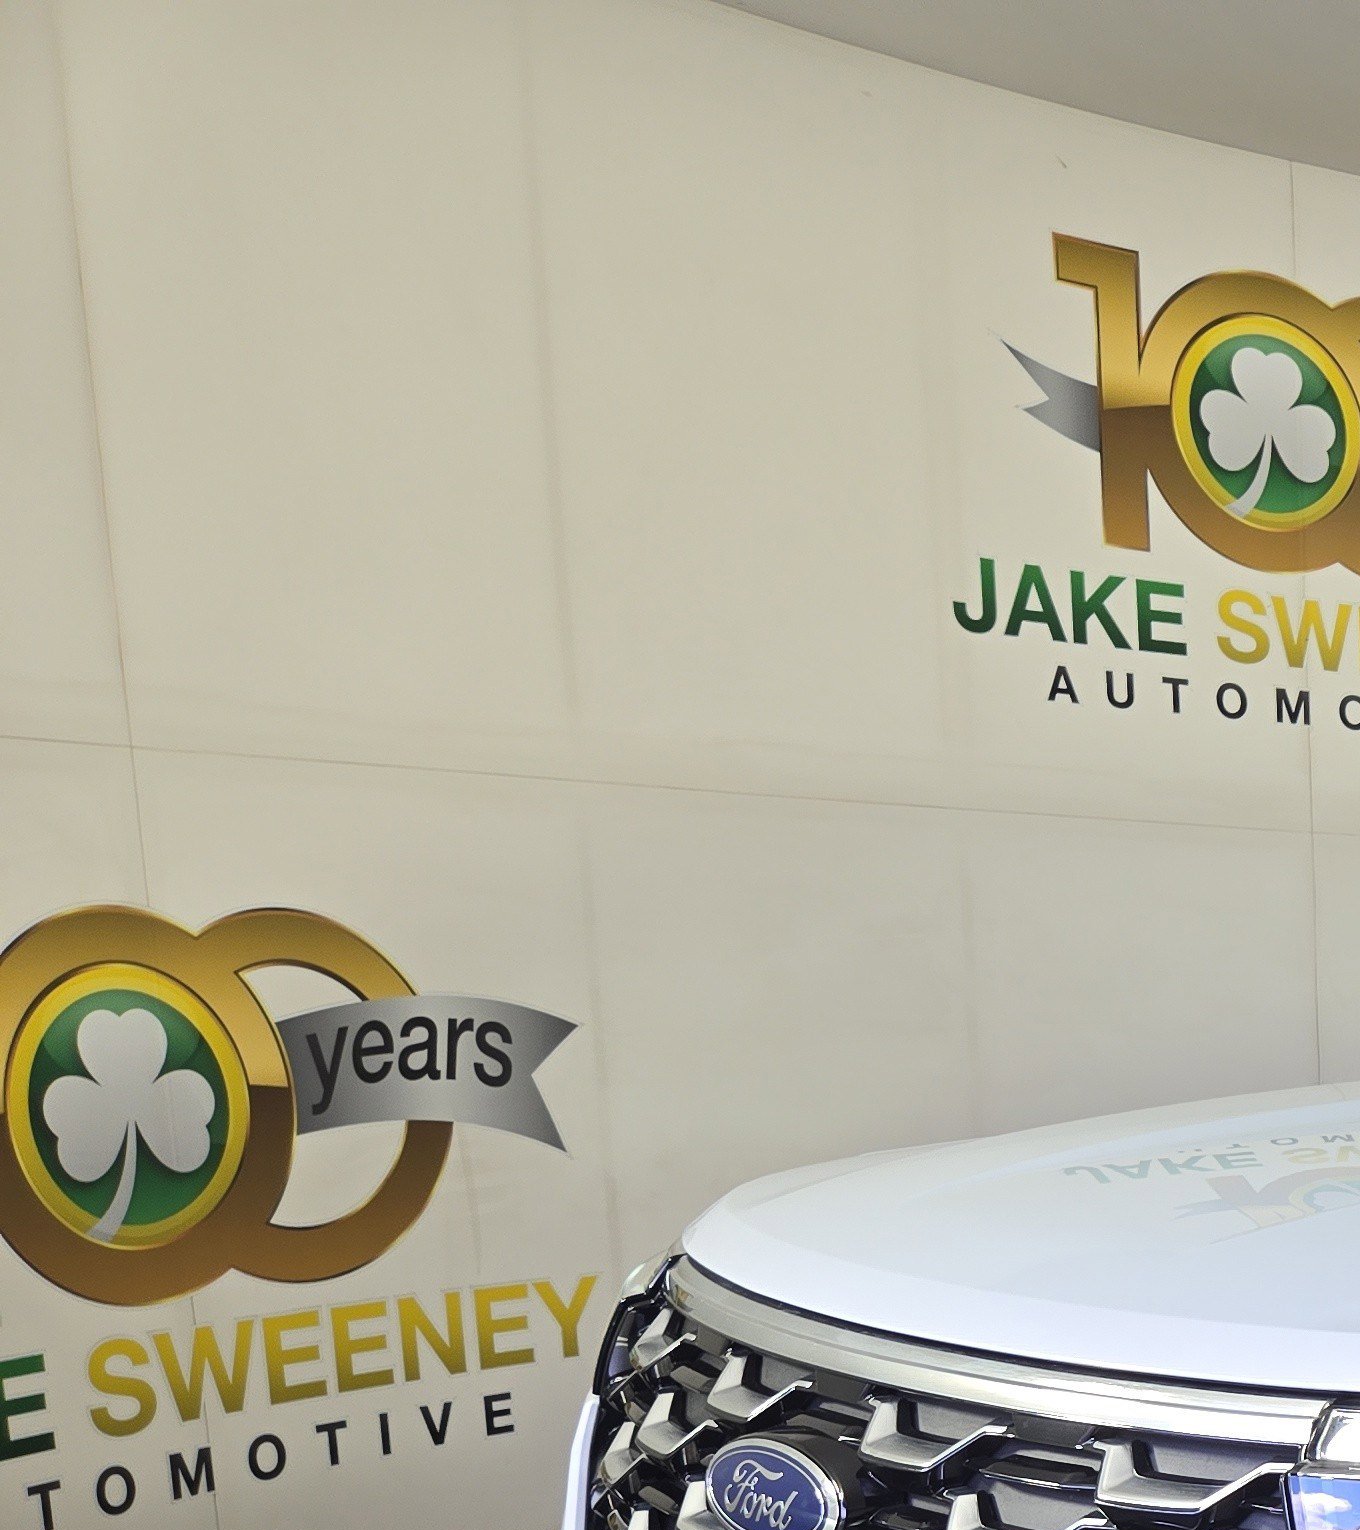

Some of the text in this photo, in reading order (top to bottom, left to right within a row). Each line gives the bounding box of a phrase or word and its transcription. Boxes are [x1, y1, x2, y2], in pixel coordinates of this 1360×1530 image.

[953, 556, 1189, 656] JAKE
[306, 1014, 513, 1115] years
[86, 1275, 602, 1438] SWEENEY
[724, 1458, 799, 1530] Ford
